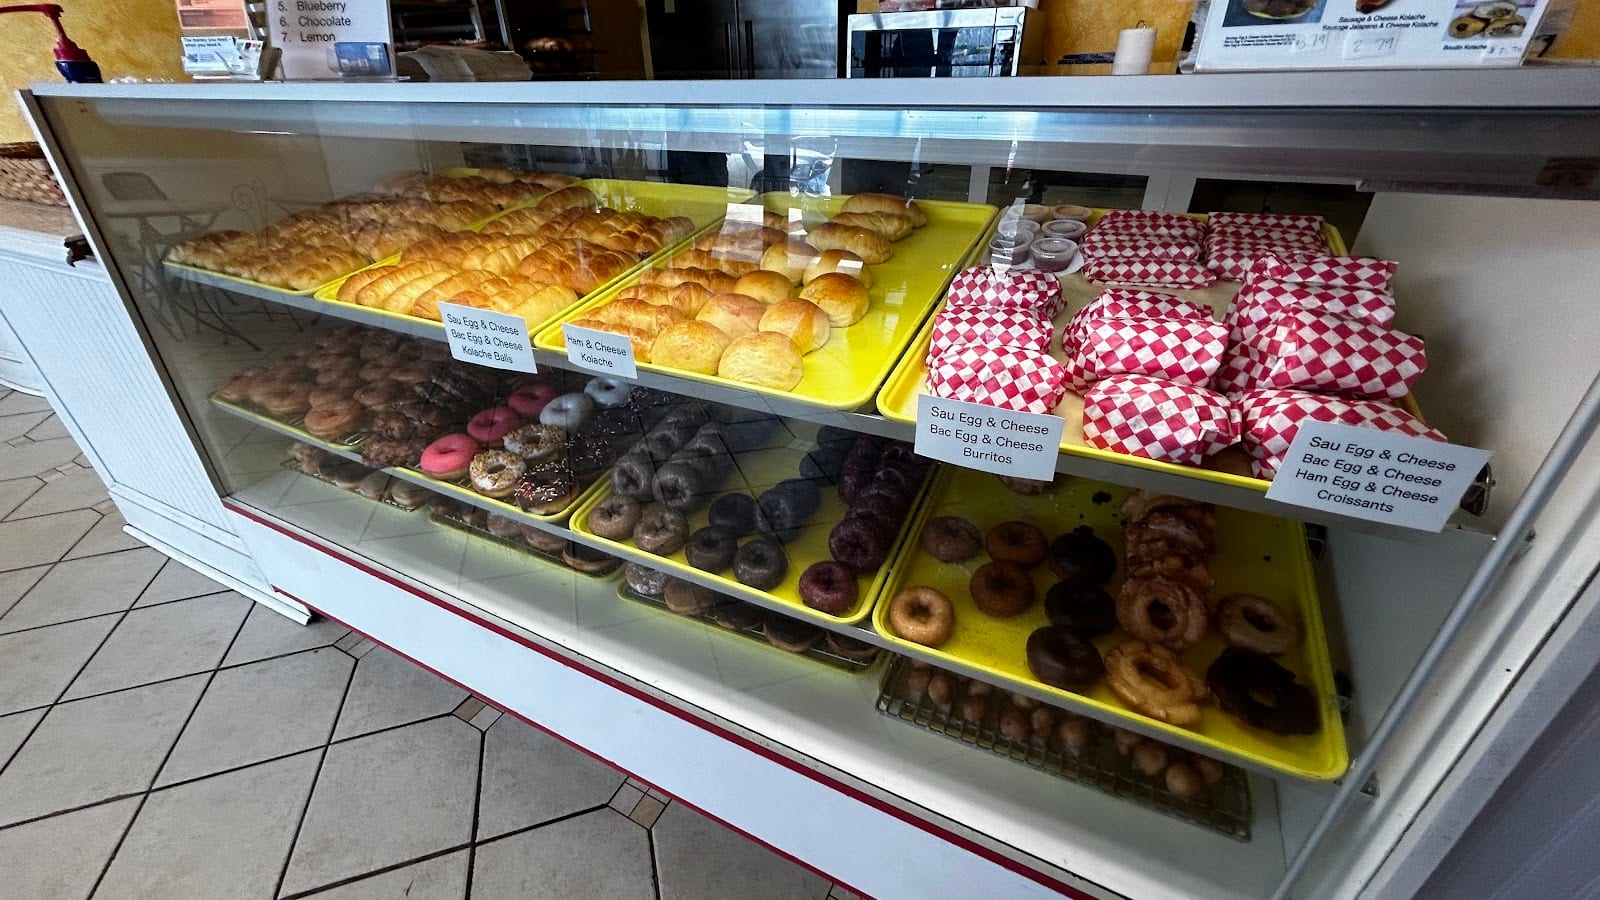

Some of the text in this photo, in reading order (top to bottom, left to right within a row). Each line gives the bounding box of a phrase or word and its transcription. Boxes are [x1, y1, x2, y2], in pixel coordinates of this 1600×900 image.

[278, 0, 346, 12] 5. Blueberry
[280, 16, 351, 27] 6. Chocolate
[1322, 24, 1350, 32] Sausage
[1339, 16, 1366, 24] Sausage
[281, 32, 336, 42] 7. Lemon
[447, 313, 519, 335] Sau Egg & Cheese
[451, 329, 523, 351] Bac Egg & Cheese
[567, 333, 627, 356] Ham & Cheese
[462, 345, 514, 364] Kolache Balls
[581, 352, 613, 368] Kolache
[931, 406, 1049, 435] Sau Egg & Cheese
[930, 424, 1044, 452] Bac Egg & Cheese
[963, 448, 1013, 464] Burritos
[1309, 436, 1456, 472] Sau Egg & Cheese
[1302, 453, 1442, 487] Bac Egg & Cheese
[1295, 468, 1439, 504] Ham Egg & Cheese
[1316, 489, 1394, 513] Croissants
